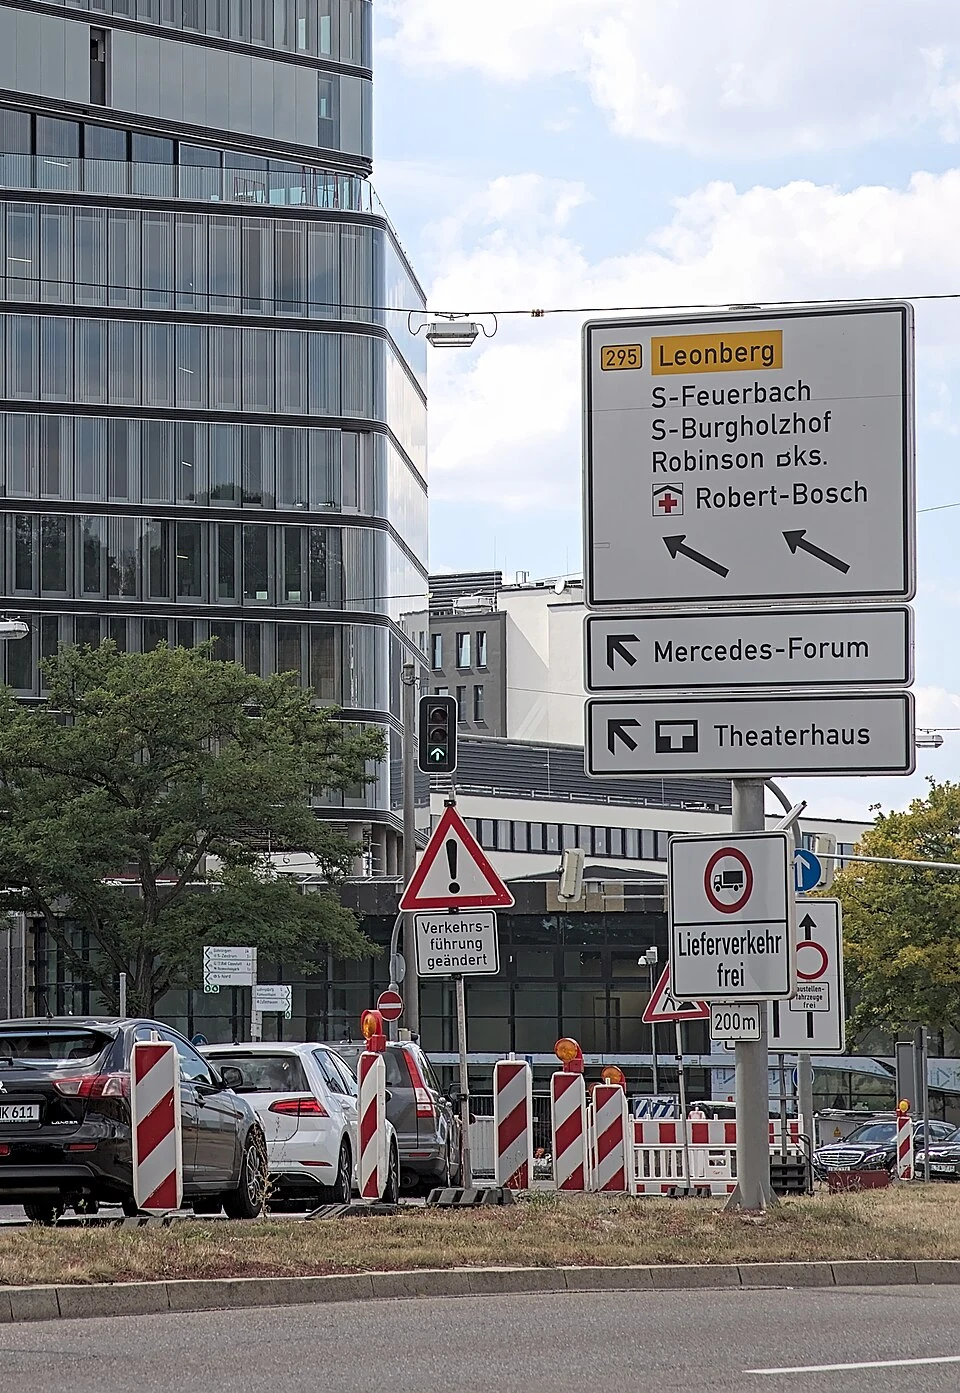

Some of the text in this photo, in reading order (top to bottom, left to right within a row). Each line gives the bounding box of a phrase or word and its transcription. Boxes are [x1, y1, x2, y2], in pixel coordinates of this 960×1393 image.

[606, 349, 637, 366] 295
[659, 341, 775, 367] Leonberg
[651, 380, 811, 409] S-Feuerbach
[651, 411, 832, 444] S-Burgholzhof
[652, 450, 764, 473] Robinson
[696, 480, 868, 509] Robert-Bosch
[654, 636, 869, 663] Mercedes-Forum
[713, 723, 870, 747] Theaterhaus
[421, 920, 490, 935] Verkehrs-
[430, 937, 483, 952] führung
[678, 929, 782, 957] Lieferverkehr
[427, 953, 488, 970] geändert
[716, 961, 745, 987] frei
[796, 985, 825, 993] austellen-
[802, 1001, 816, 1009] frei
[11, 1106, 34, 1119] 611
